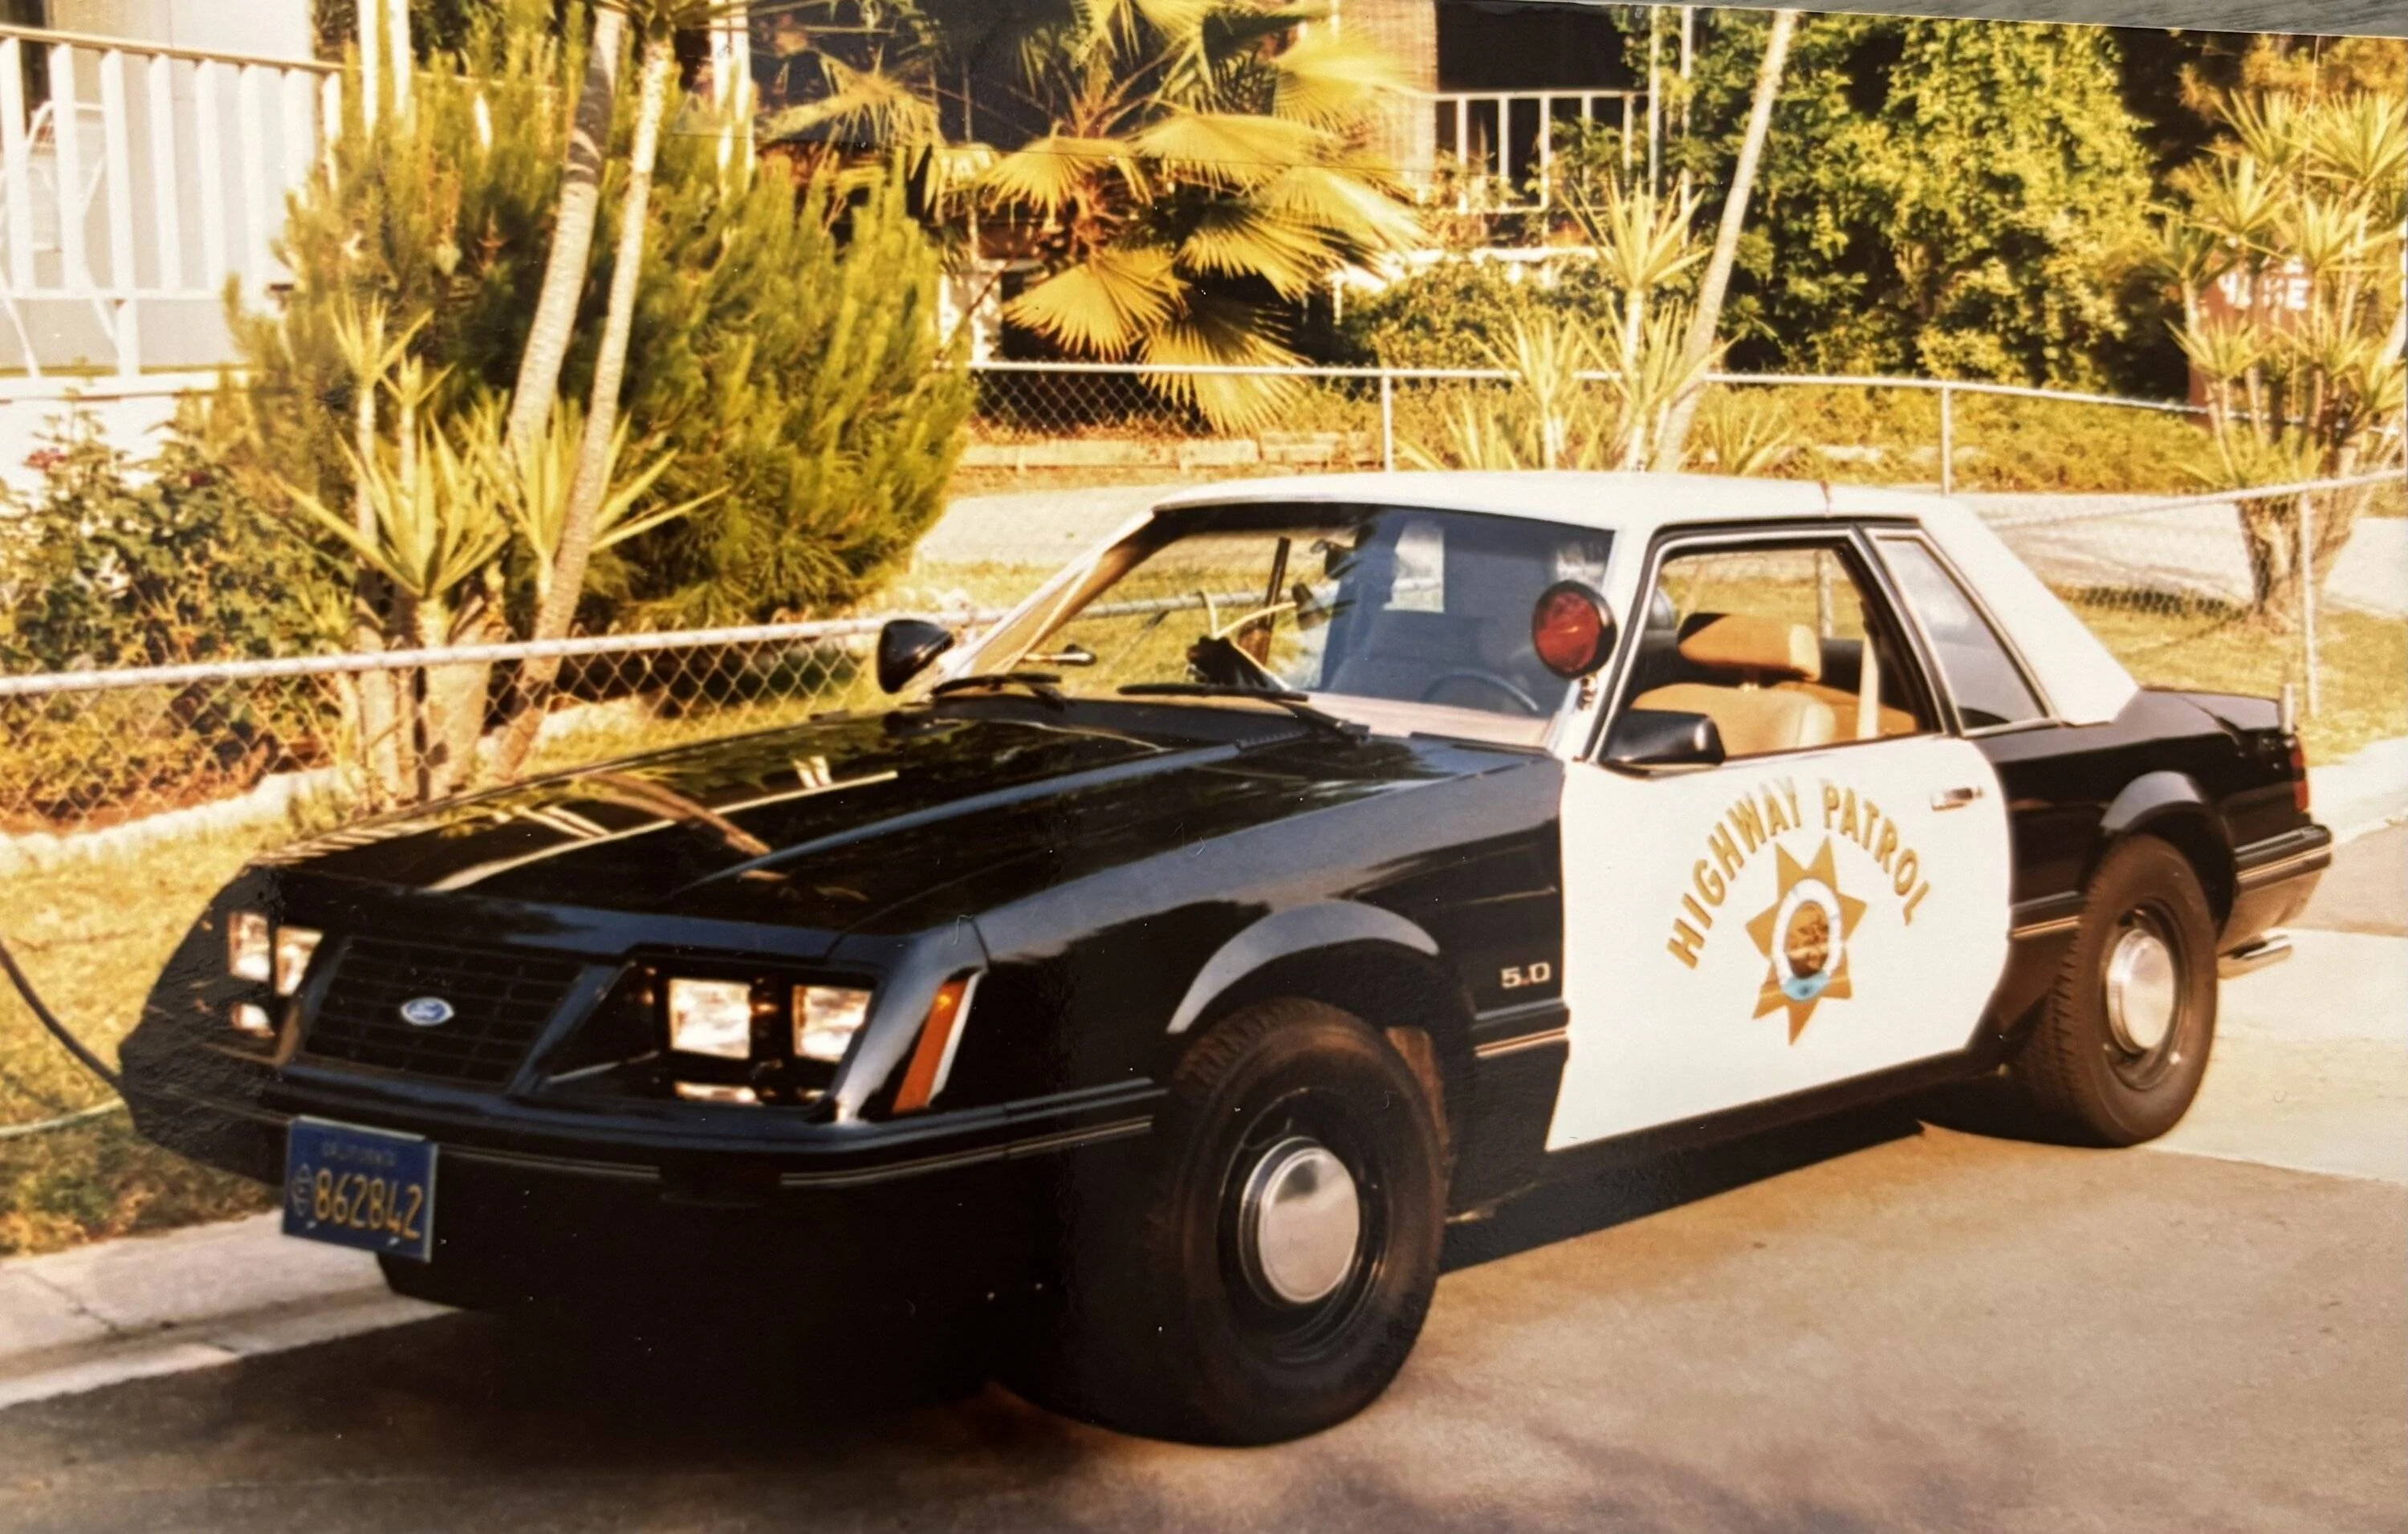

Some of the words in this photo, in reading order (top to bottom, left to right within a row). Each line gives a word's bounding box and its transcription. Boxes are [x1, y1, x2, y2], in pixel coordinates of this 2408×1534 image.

[1667, 777, 1800, 969] HIGHWAY
[1820, 779, 1930, 926] PATROL
[1501, 962, 1551, 988] 5.0
[315, 1168, 423, 1239] 862842
